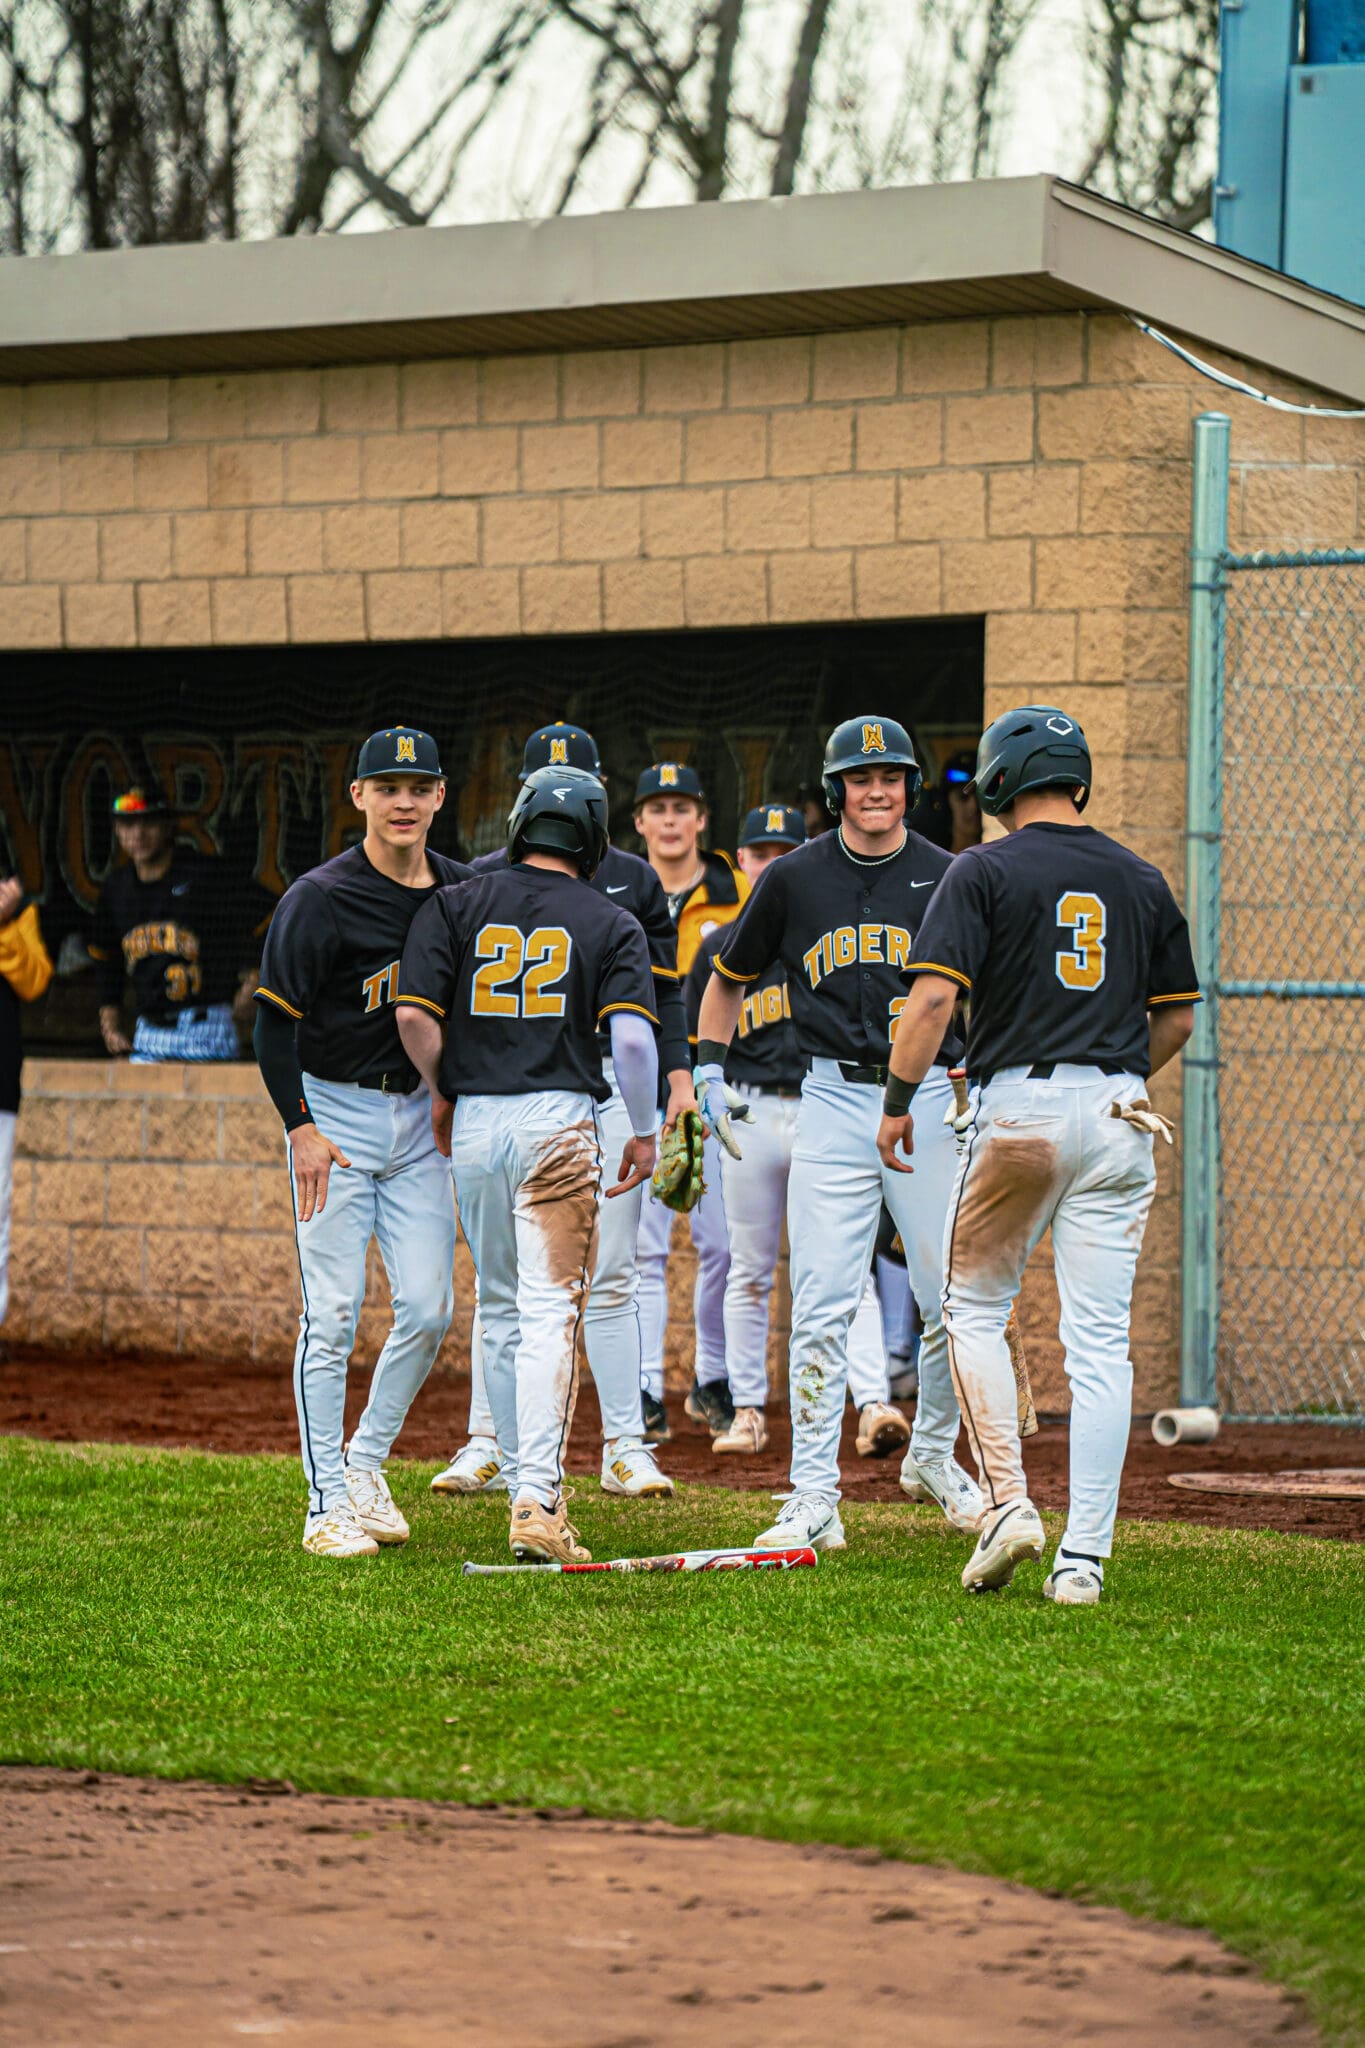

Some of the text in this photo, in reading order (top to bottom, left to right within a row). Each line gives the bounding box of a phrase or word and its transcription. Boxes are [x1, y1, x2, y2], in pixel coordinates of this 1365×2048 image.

[470, 923, 573, 1018] 22
[803, 924, 911, 991] TIGER
[1055, 891, 1106, 992] 3
